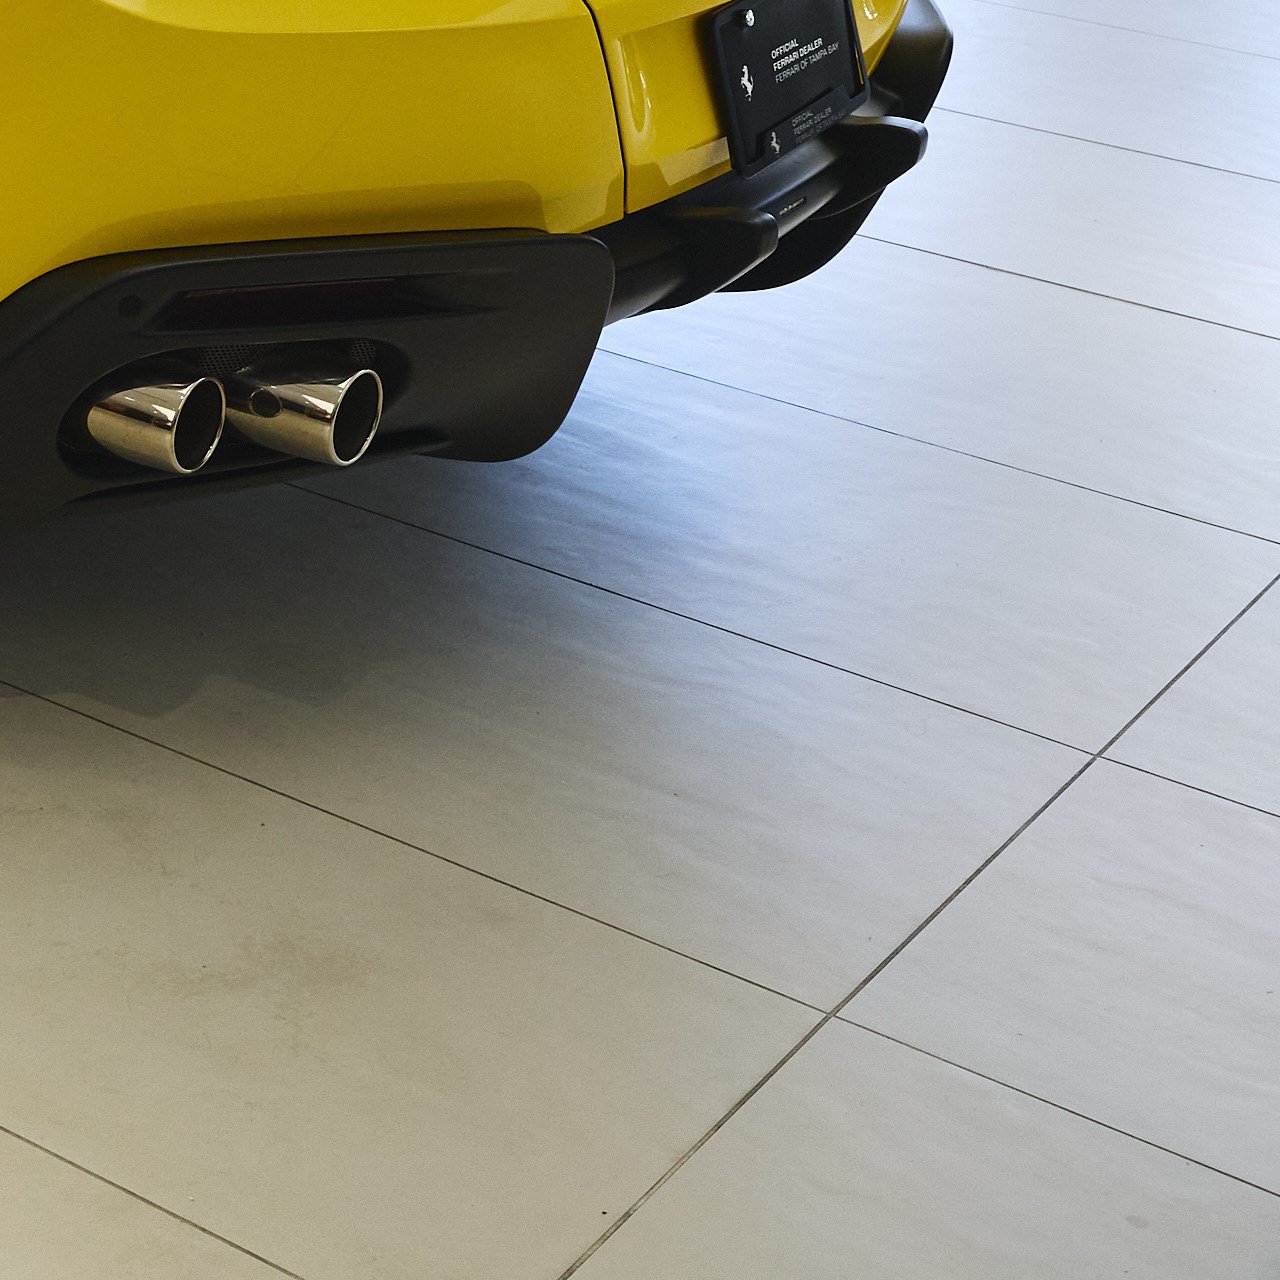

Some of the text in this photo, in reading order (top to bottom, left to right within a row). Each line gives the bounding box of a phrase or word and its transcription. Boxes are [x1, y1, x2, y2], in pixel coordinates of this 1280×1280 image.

[771, 38, 799, 59] OFFICIAL
[773, 37, 823, 72] FERRARI DEALER
[775, 41, 840, 84] FERRARI OF TAMPA BAY
